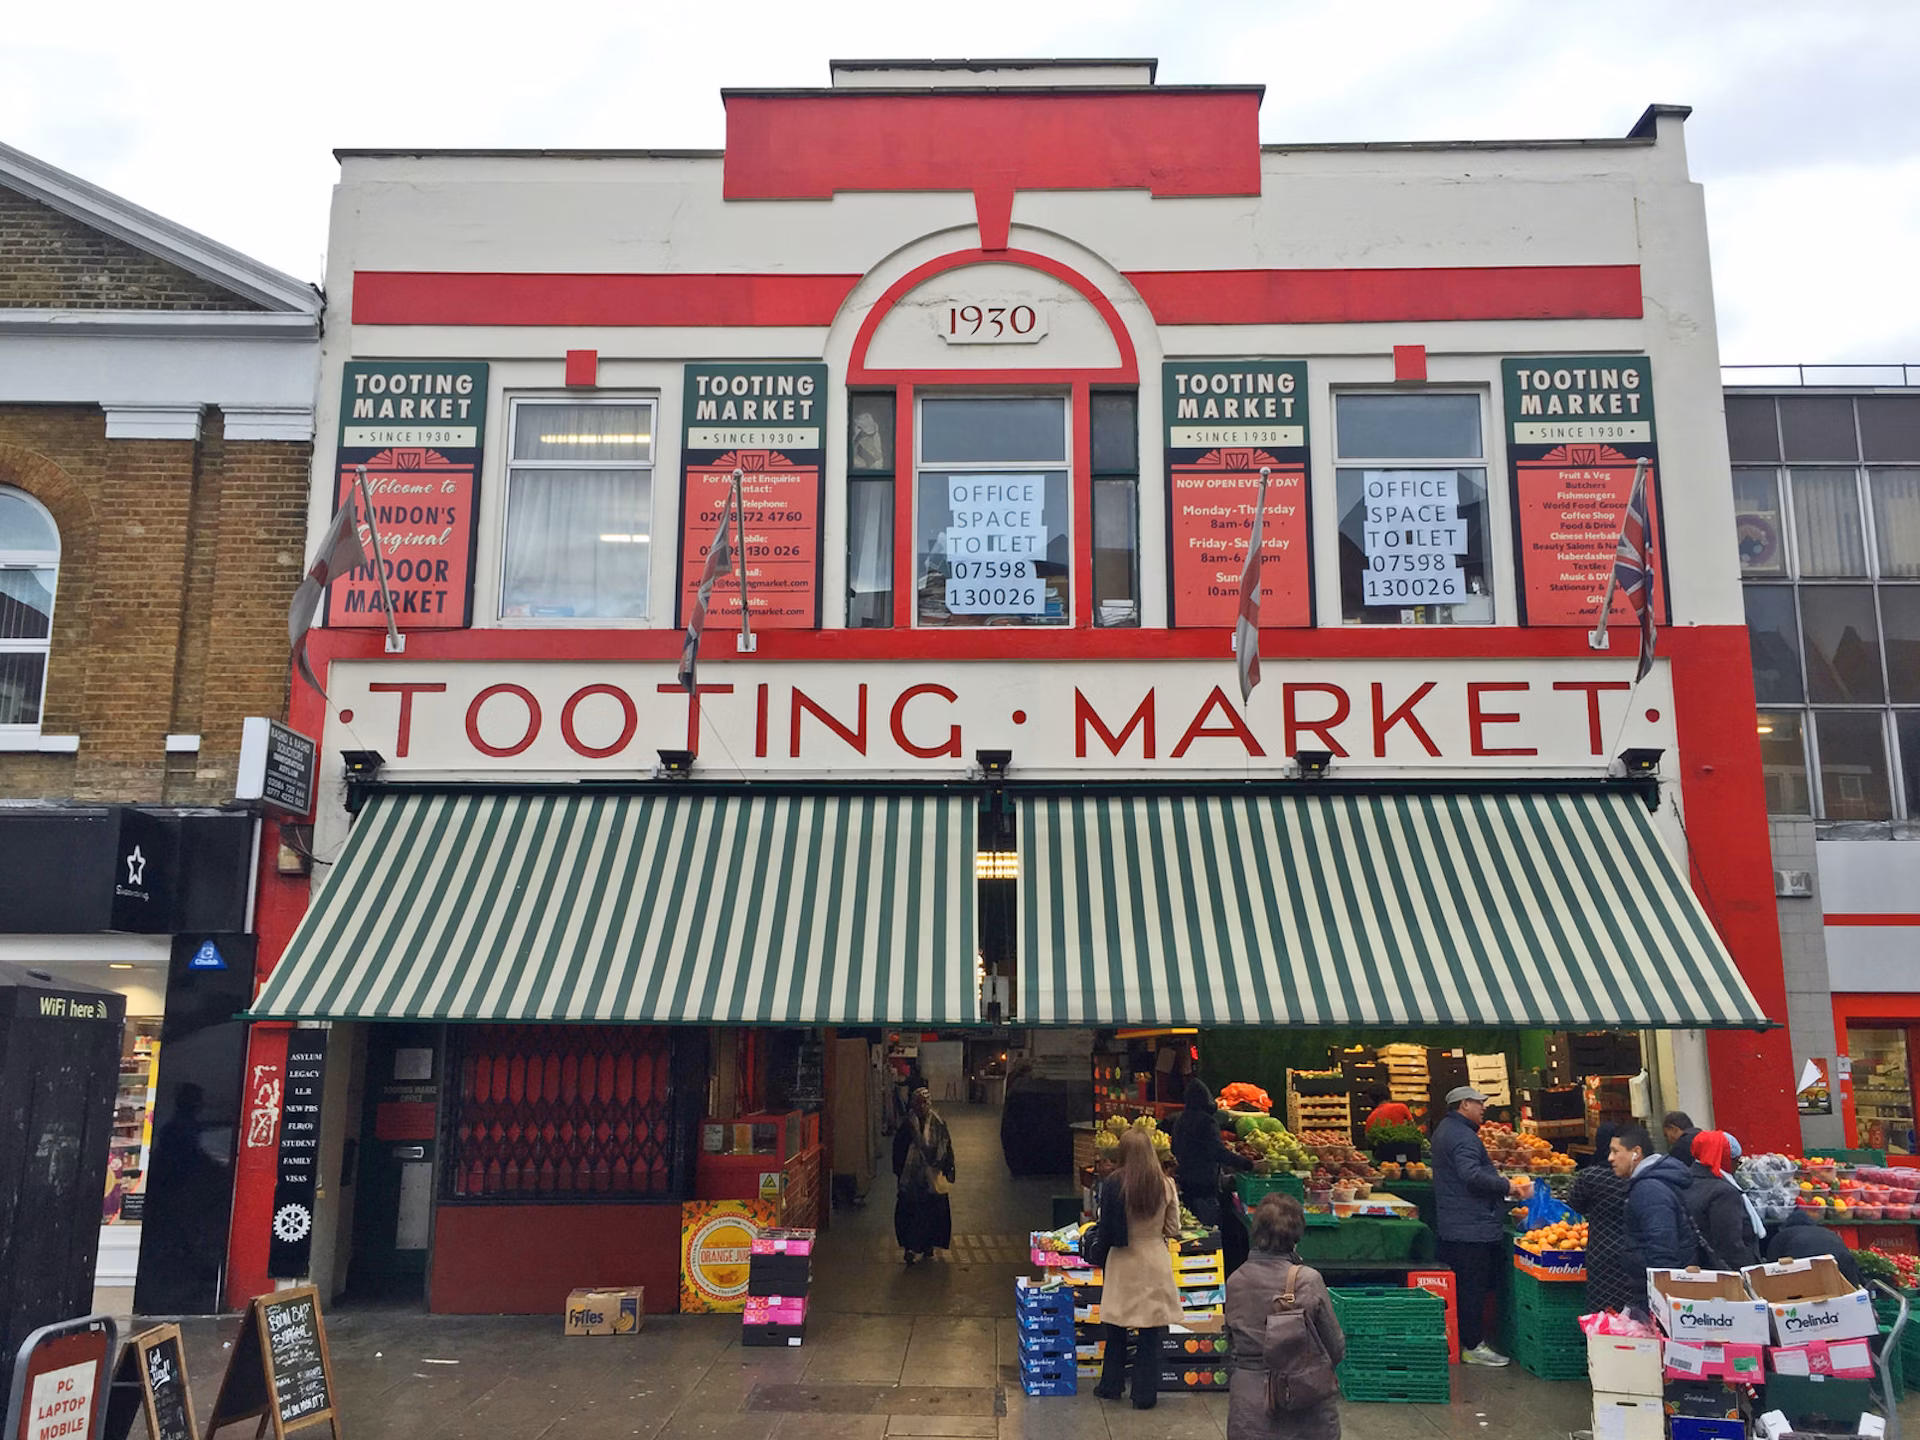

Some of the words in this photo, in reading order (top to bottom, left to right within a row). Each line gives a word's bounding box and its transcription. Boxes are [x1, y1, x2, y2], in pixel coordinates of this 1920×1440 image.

[950, 305, 1036, 337] 1930
[355, 373, 473, 395] TOOTING
[696, 375, 814, 396] TOOTING
[1175, 373, 1295, 394] TOOTING
[1517, 368, 1640, 391] TOOTING
[353, 398, 471, 419] MARKET
[696, 400, 813, 420] MARKET
[1177, 397, 1295, 419] MARKET
[1520, 393, 1640, 415] MARKET
[370, 431, 411, 442] SINCE
[418, 431, 450, 442] 1930
[714, 433, 755, 444] SINCE
[761, 433, 794, 444] 1930
[1196, 431, 1238, 442] SINCE
[1244, 431, 1277, 442] 1930
[1541, 427, 1584, 438] SINCE
[1590, 426, 1623, 437] 1930
[703, 475, 719, 483] For
[721, 475, 757, 483] Mket
[759, 475, 800, 485] Enquiries
[1176, 479, 1204, 488] NOW
[1206, 479, 1236, 488] OPEN
[1276, 478, 1299, 487] DAY
[1559, 471, 1581, 480] Fruit
[1593, 471, 1611, 480] Veg
[355, 478, 434, 495] Welcome
[440, 479, 456, 494] to
[953, 485, 1034, 502] OFFICE
[1368, 481, 1448, 498] OFFICE
[1557, 492, 1616, 501] Fishmongers
[768, 511, 802, 522] 4760
[957, 511, 1031, 528] SPACE
[1371, 505, 1447, 523] SPACE
[1561, 511, 1591, 519] Coffee
[1593, 511, 1615, 521] Shop
[1550, 532, 1583, 540] Chinese
[747, 546, 769, 556] 130
[774, 546, 800, 556] 026
[1533, 543, 1564, 551] Beauty
[1566, 543, 1595, 551] Salons
[349, 559, 449, 582] INDOOR
[955, 561, 1026, 579] 07598
[1373, 554, 1446, 572] 07598
[1560, 573, 1586, 581] Music
[1588, 573, 1595, 581] &
[1368, 578, 1455, 597] 130026
[344, 590, 447, 613] MARKET
[950, 588, 1036, 606] 130026
[369, 682, 962, 759] TOOTING
[1075, 682, 1630, 758] MARKET
[40, 997, 66, 1016] WiFi
[69, 999, 95, 1018] here
[290, 1053, 323, 1061] ASYLUM
[289, 1070, 320, 1078] LEGACY
[283, 1157, 312, 1165] FAMILY
[701, 1250, 733, 1263] ORANGE
[1548, 1263, 1584, 1275] nobel
[1417, 1277, 1448, 1288] TYSKIE
[1680, 1314, 1734, 1327] Melinda
[1786, 1312, 1839, 1330] Melinda
[57, 1378, 74, 1393] PC
[38, 1396, 86, 1420] LAPTOP
[40, 1418, 84, 1440] MOBILE
